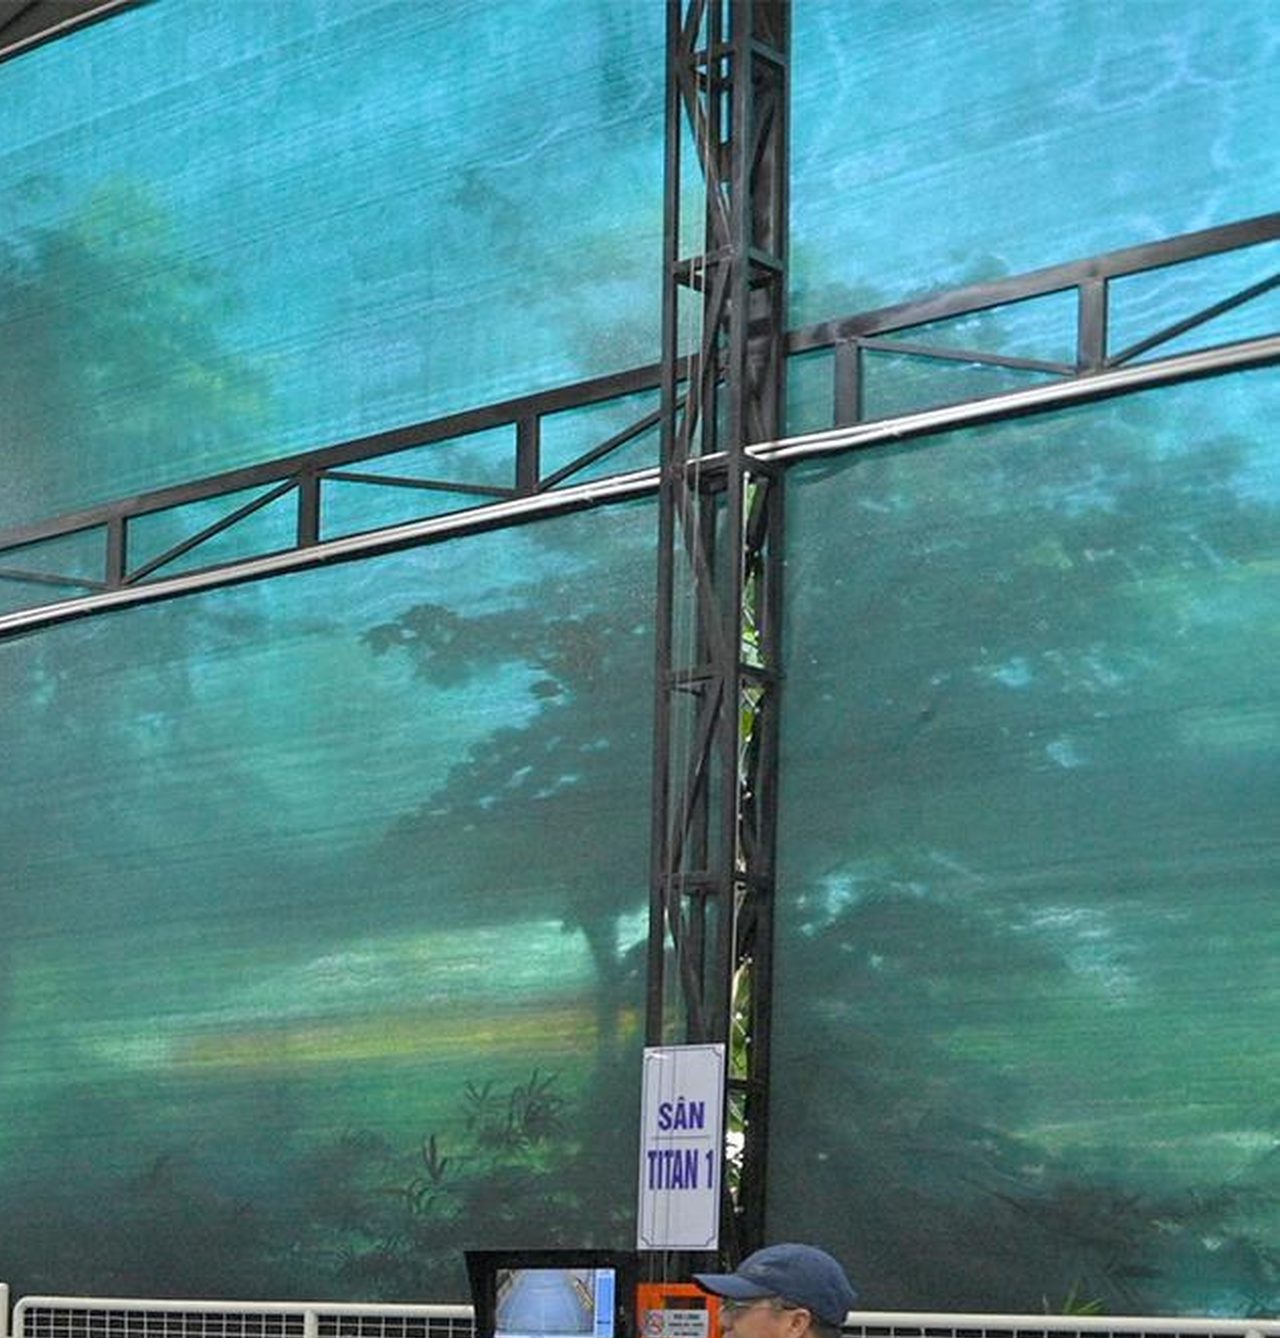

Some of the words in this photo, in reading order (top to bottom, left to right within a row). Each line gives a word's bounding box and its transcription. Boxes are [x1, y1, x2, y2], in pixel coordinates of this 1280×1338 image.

[658, 1096, 705, 1130] SÂN
[647, 1150, 698, 1190] TITAN
[705, 1151, 715, 1190] 1
